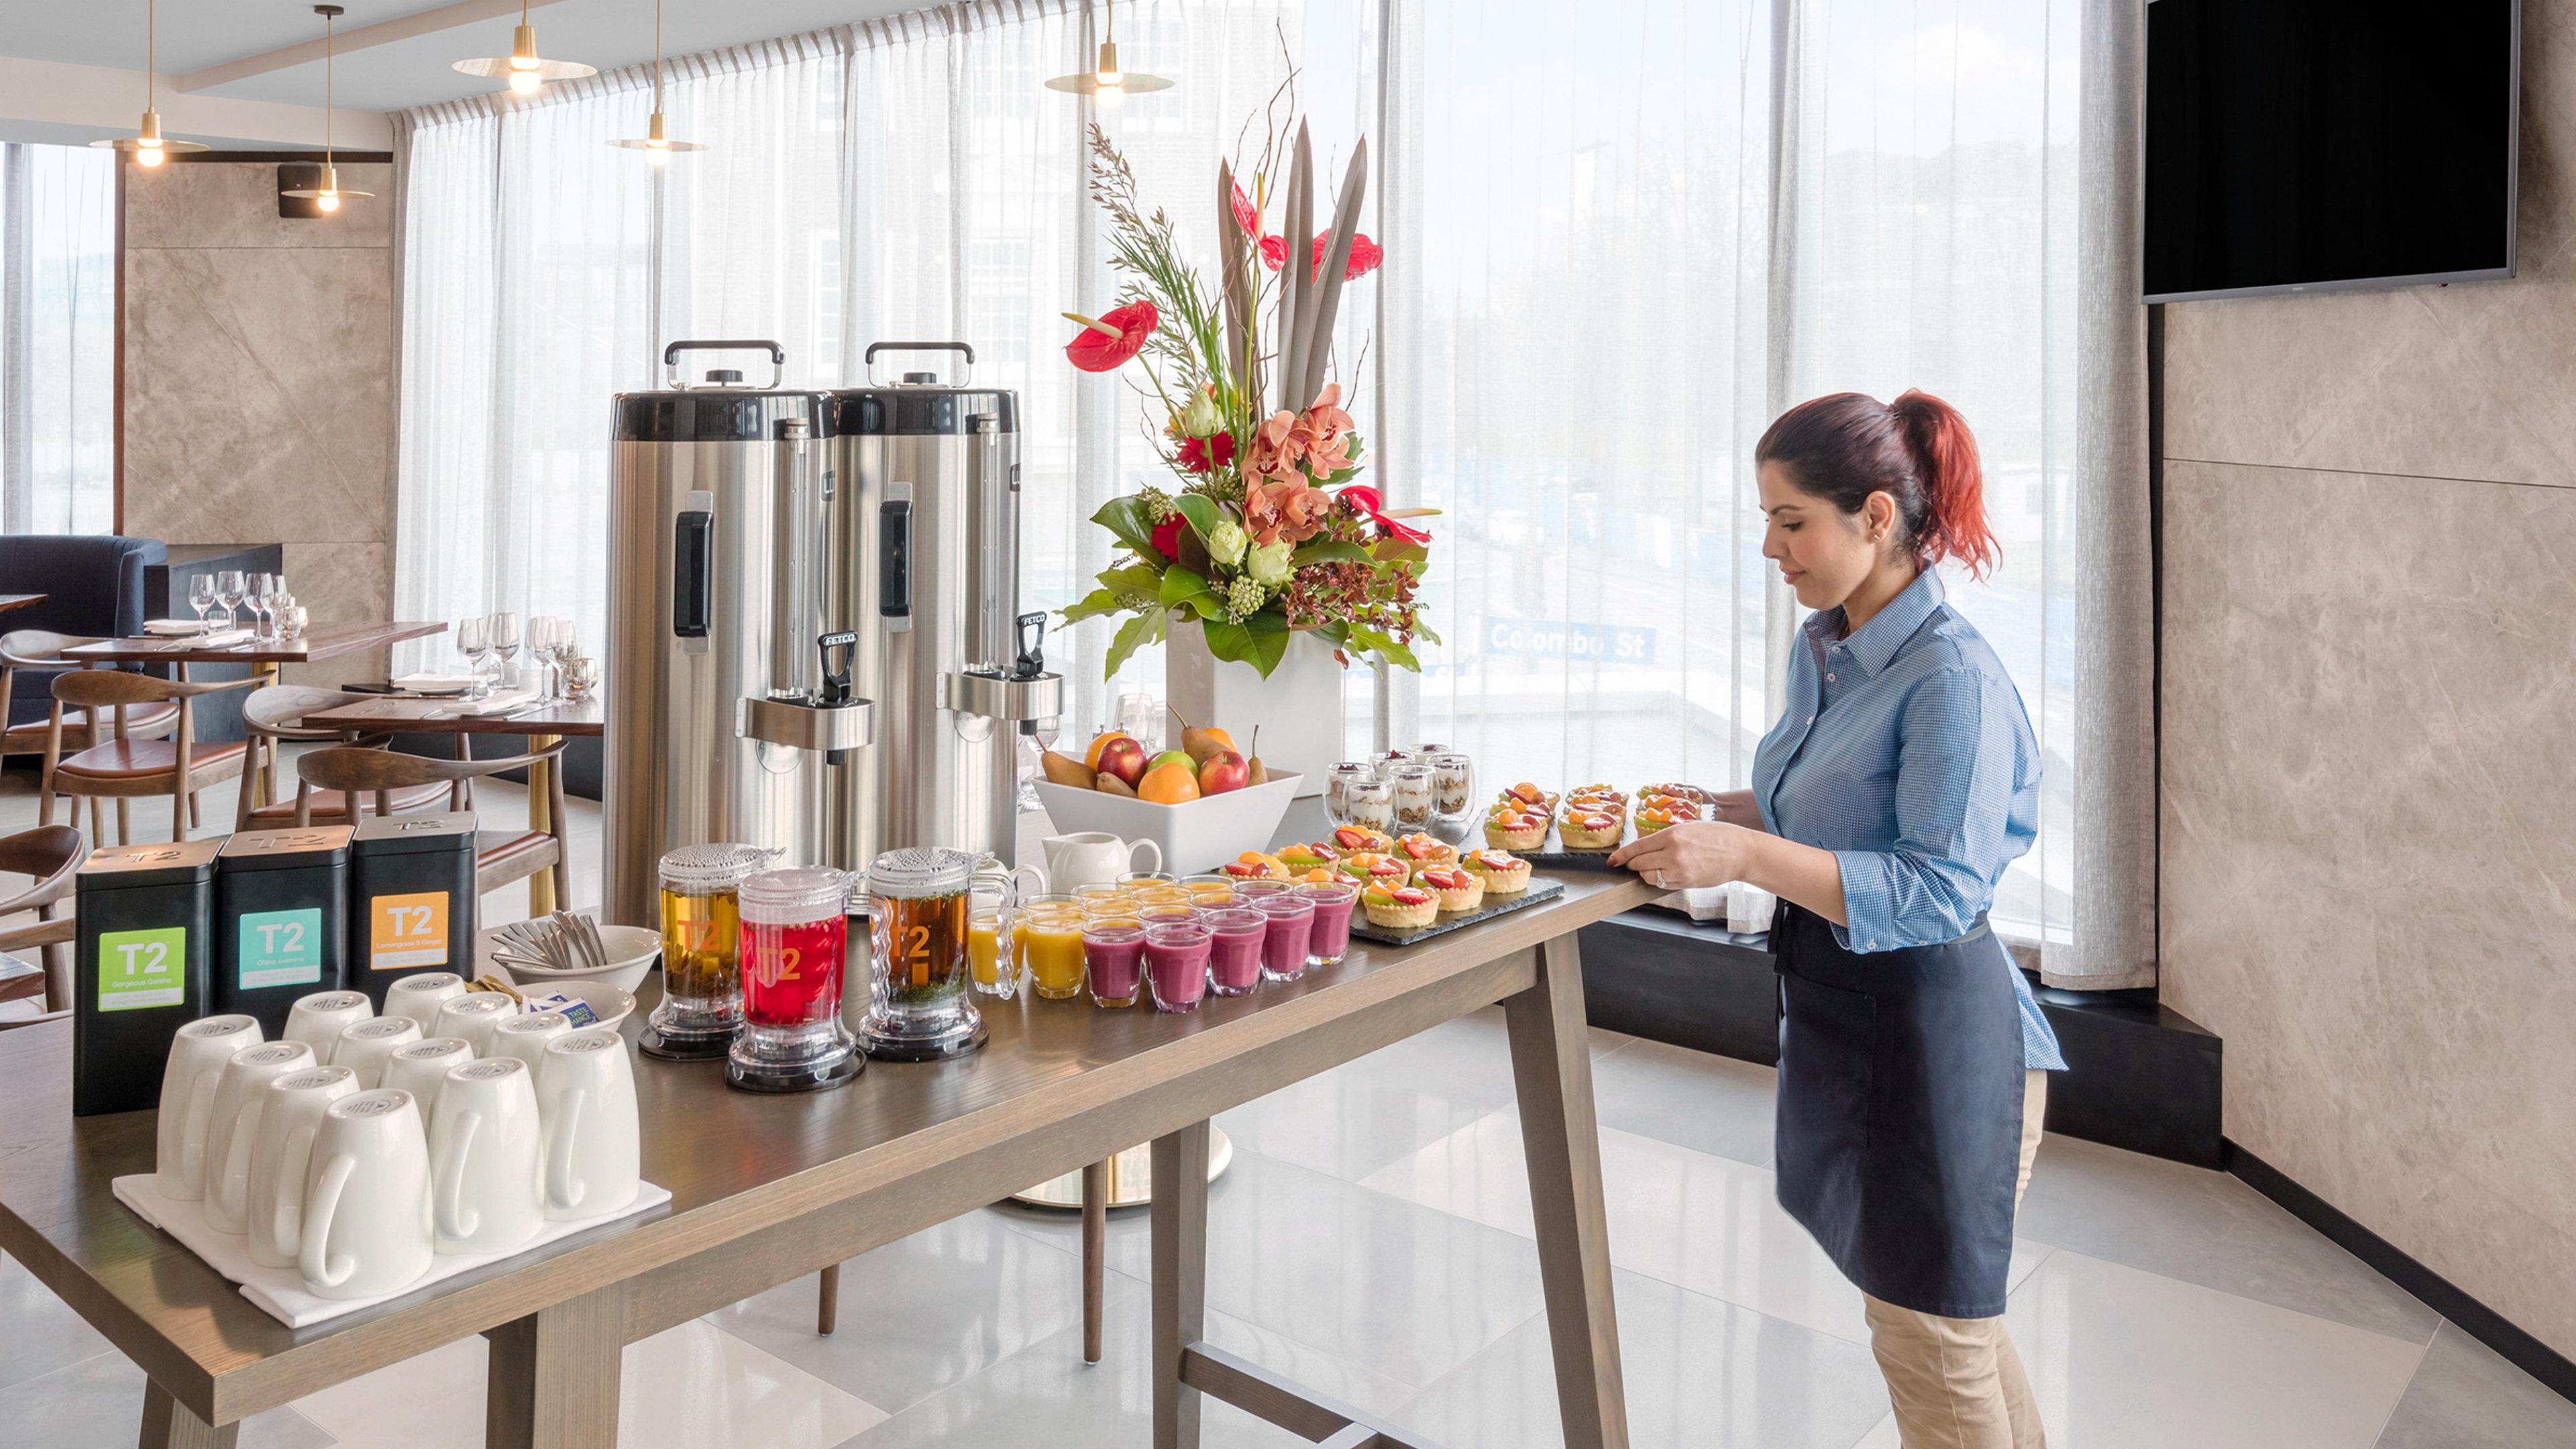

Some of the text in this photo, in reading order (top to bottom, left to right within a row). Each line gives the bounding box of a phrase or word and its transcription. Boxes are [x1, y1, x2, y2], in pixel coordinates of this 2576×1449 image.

[1024, 614, 1045, 625] FETCO
[826, 634, 855, 645] FETCO
[1491, 623, 1645, 658] Coombo St
[125, 851, 180, 863] T2
[248, 835, 327, 849] T2
[386, 906, 432, 936] T2
[677, 920, 720, 951] T2
[257, 922, 305, 954] T2
[889, 926, 930, 957] T2
[117, 942, 168, 975] T2
[759, 947, 800, 980] T2
[569, 1006, 589, 1017] TASTE
